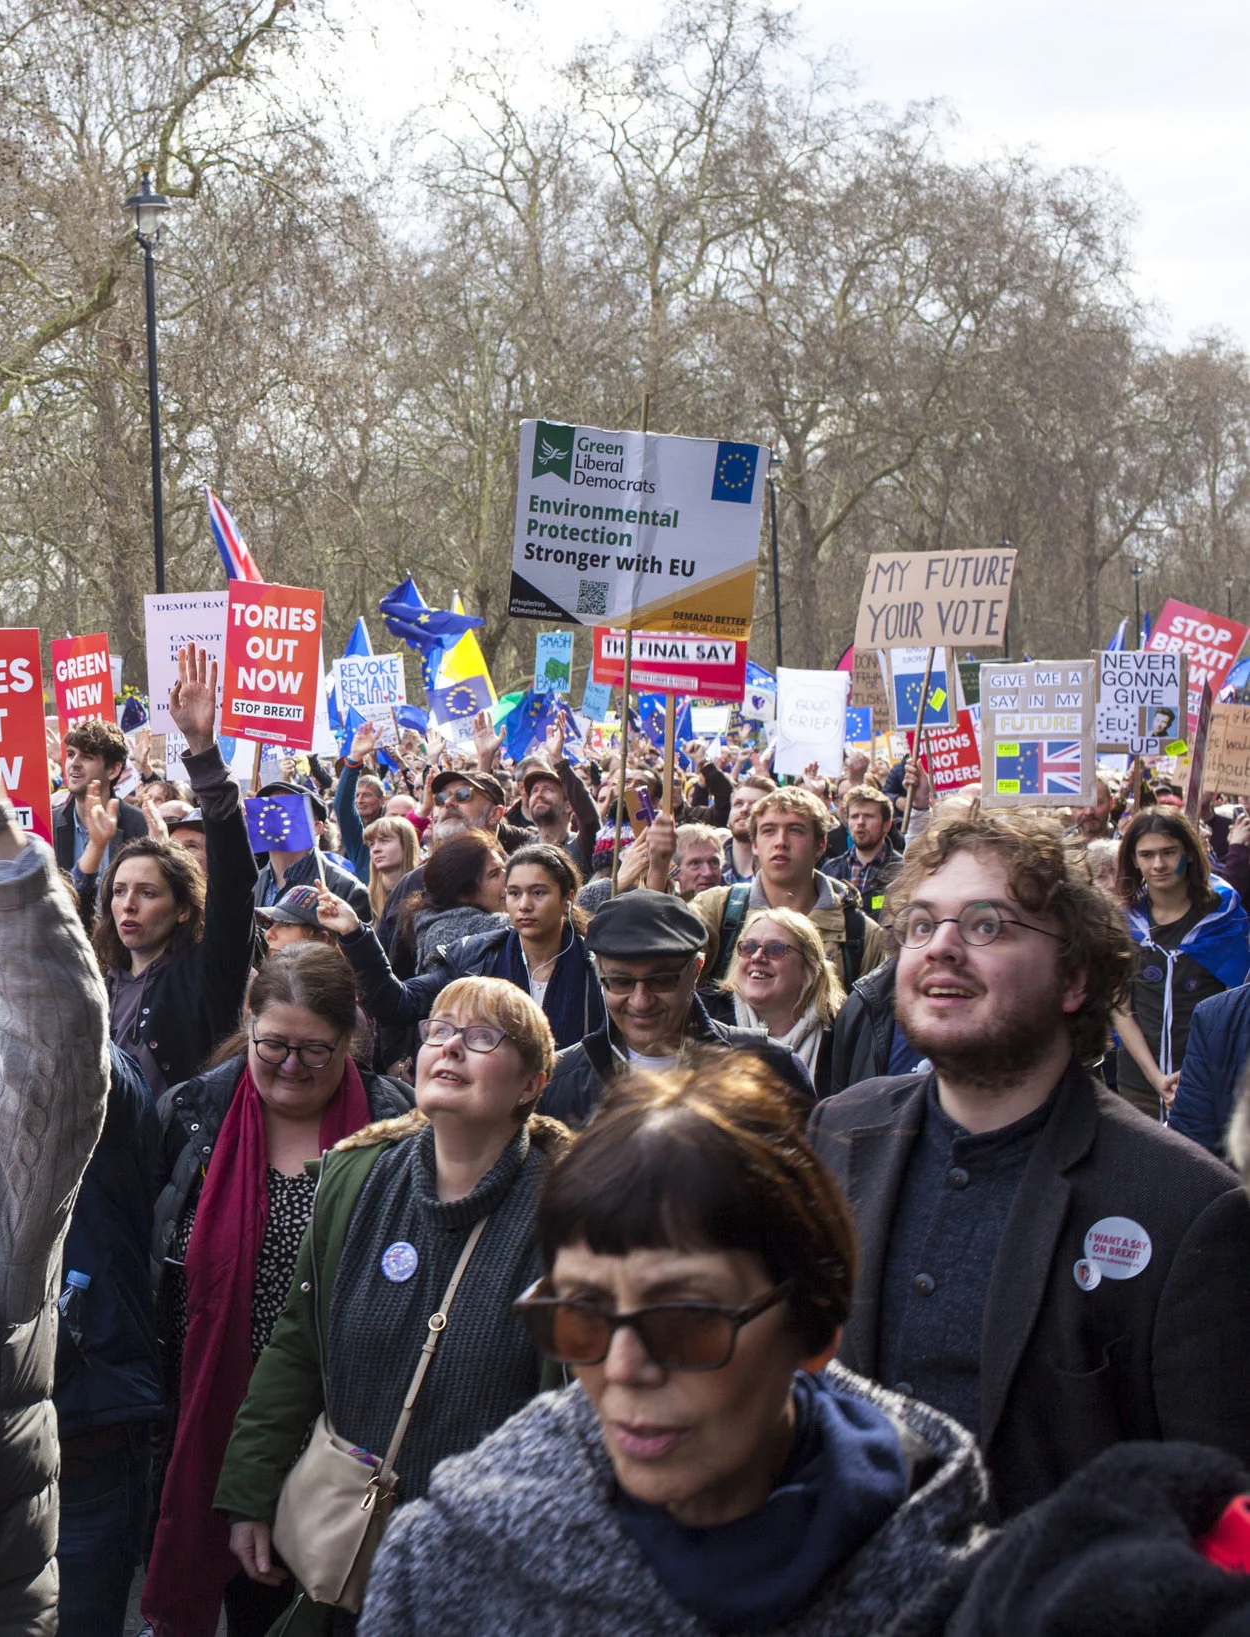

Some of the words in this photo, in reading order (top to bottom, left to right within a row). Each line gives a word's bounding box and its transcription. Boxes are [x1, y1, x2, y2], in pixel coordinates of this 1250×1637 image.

[577, 436, 624, 456] Green
[575, 454, 624, 474] Liberal
[573, 470, 656, 494] Democrats
[528, 494, 679, 528] Environmental
[526, 518, 632, 547] Protection
[524, 542, 610, 572] Stronger
[616, 552, 663, 574] with
[669, 558, 696, 577] EU
[871, 560, 911, 594] MY
[925, 555, 1013, 590] FUTURE
[153, 600, 228, 611] 'DEMOCRAC
[511, 598, 547, 608] #PeoplesVote
[231, 603, 317, 632] TORIES
[510, 606, 563, 618] #ClimateBreakdown
[673, 611, 712, 623] DEMAND
[716, 615, 747, 625] BETTER
[867, 601, 924, 642] YOUR
[937, 599, 1003, 636] VOTE
[671, 621, 688, 630] FOR
[690, 623, 708, 633] OUR
[710, 625, 746, 637] CLIMATE
[1169, 615, 1232, 647] STOP
[170, 634, 222, 642] CANNOT
[540, 633, 572, 648] SMASH
[245, 636, 299, 663] OUT
[604, 638, 633, 655] TH
[639, 642, 690, 659] FINAL
[696, 644, 733, 661] SAY
[1150, 632, 1234, 671] BREXIT
[56, 651, 108, 682] GREEN
[340, 659, 399, 678] REVOKE
[1104, 654, 1176, 670] NEVER
[237, 666, 304, 695] NOW
[341, 675, 398, 694] REMAIN
[991, 674, 1026, 687] GIVE
[1036, 672, 1060, 684] ME
[1070, 672, 1081, 684] A
[1102, 671, 1179, 687] GONNA
[65, 682, 102, 710] NEW
[343, 690, 397, 707] REBUILD
[989, 695, 1018, 708] SAY
[1029, 695, 1044, 706] IN
[1056, 694, 1081, 705] MY
[1114, 688, 1164, 705] GIVE
[234, 701, 261, 715] STOP
[263, 704, 303, 719] BREXIT
[1000, 715, 1078, 732] FUTURE
[1106, 717, 1129, 732] EU
[1130, 739, 1159, 754] UP
[931, 752, 959, 769] NOT
[1094, 1233, 1121, 1246] WANT
[1122, 1238, 1129, 1247] A
[1130, 1239, 1149, 1250] SAY
[1092, 1243, 1107, 1253] ON
[1109, 1247, 1142, 1260] BREXIT
